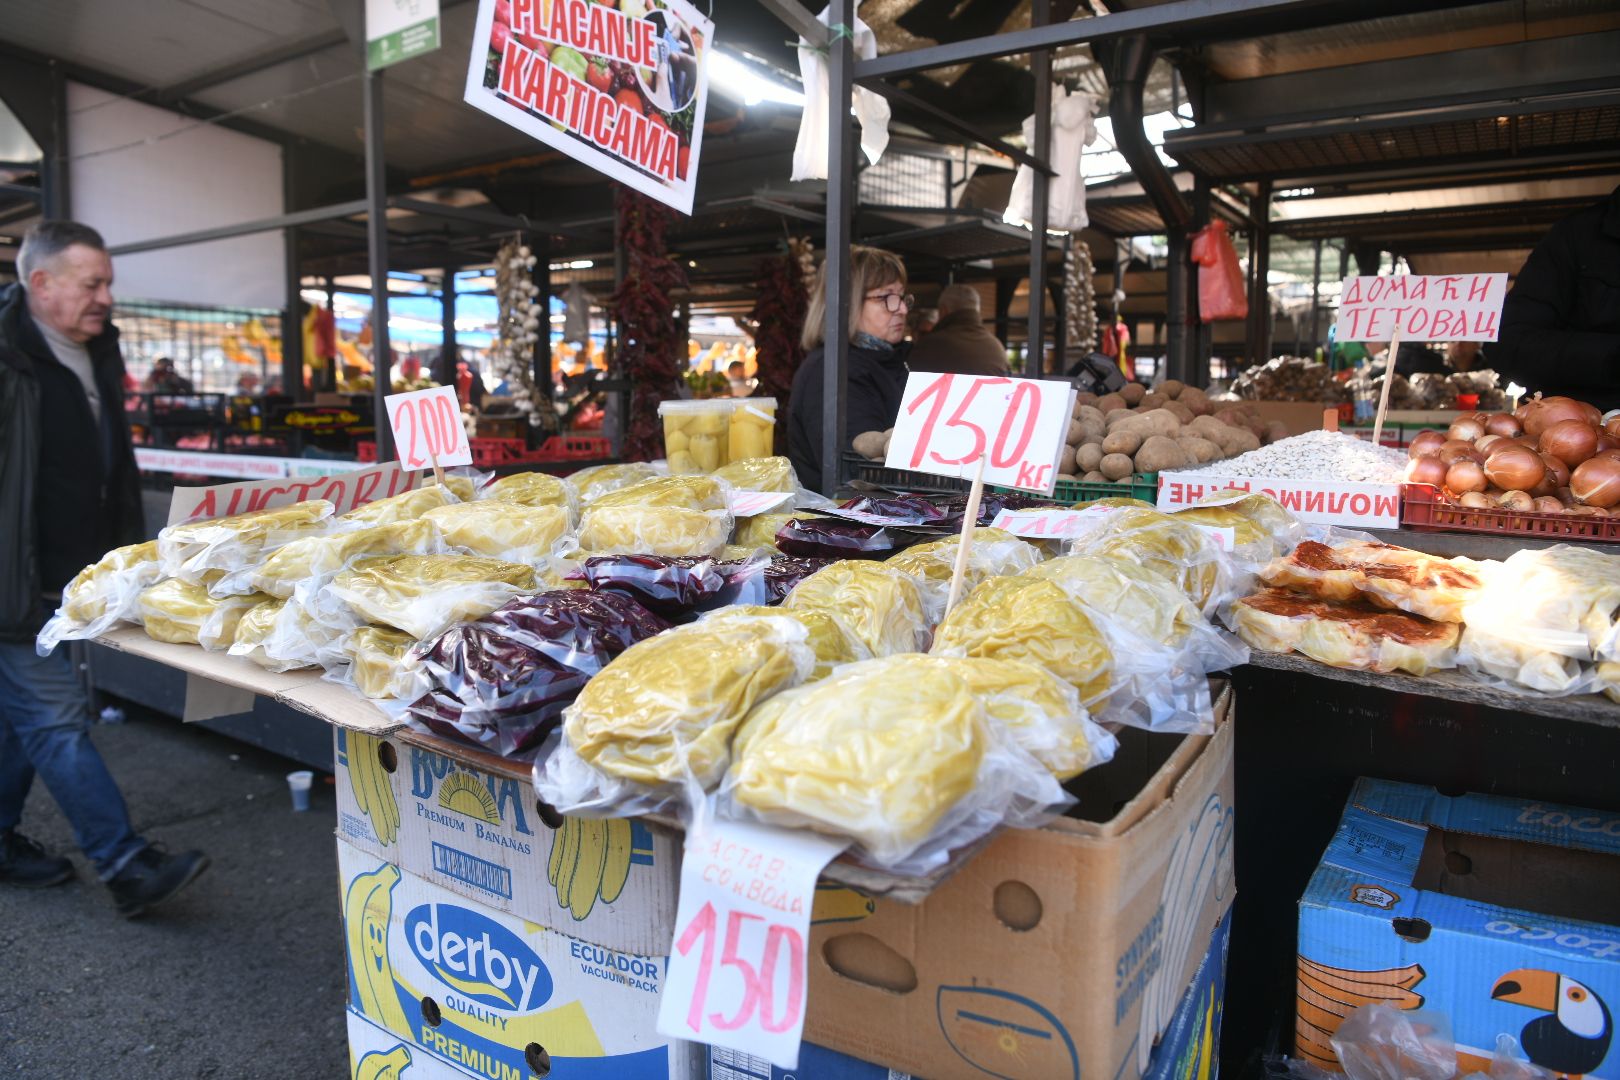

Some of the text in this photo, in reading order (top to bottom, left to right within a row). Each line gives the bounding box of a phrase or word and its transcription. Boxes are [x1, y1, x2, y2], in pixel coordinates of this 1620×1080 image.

[502, 40, 678, 181] KARTICAMA
[1343, 276, 1492, 305] ДОМАЋИ
[1346, 305, 1496, 338] ТЕТОВАЦ
[394, 395, 457, 467] 200
[907, 372, 1041, 469] 150
[416, 802, 531, 855] PREMIUM BANANAS
[414, 903, 539, 1014] derby
[570, 941, 658, 980] ECUADOR
[581, 963, 658, 994] VACUUM PACK
[675, 900, 804, 1033] 150
[445, 995, 508, 1032] QUALITY
[421, 1026, 520, 1080] PREMIUM
